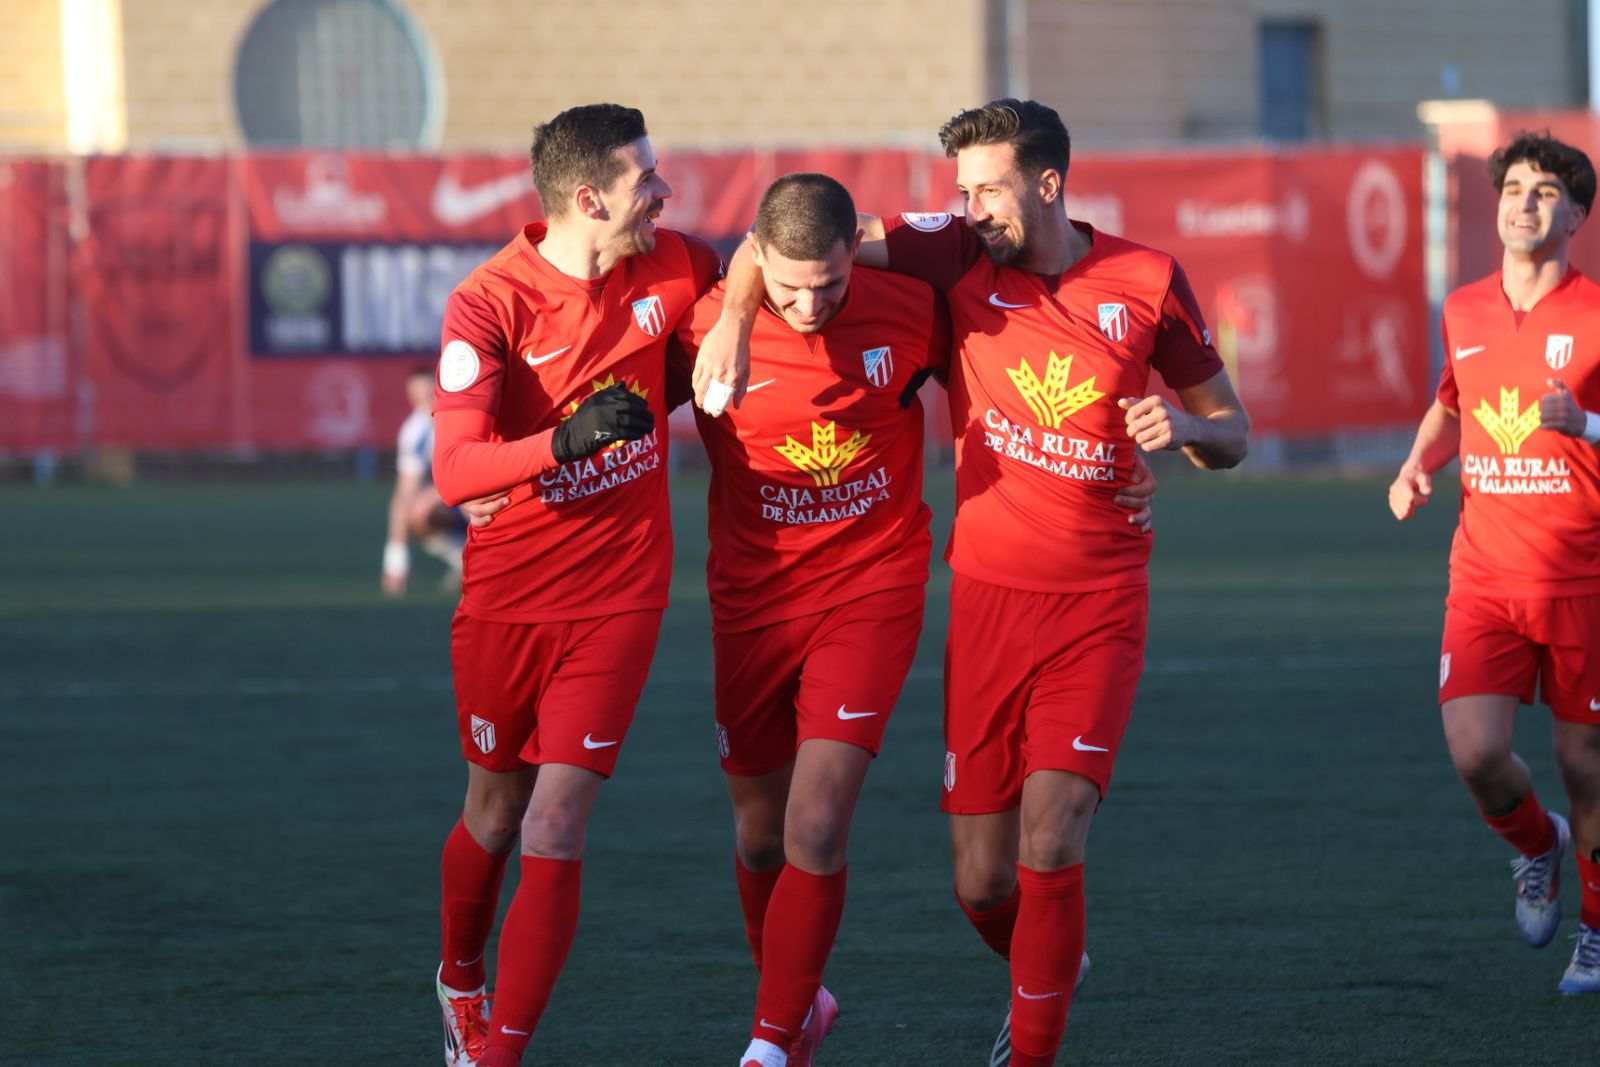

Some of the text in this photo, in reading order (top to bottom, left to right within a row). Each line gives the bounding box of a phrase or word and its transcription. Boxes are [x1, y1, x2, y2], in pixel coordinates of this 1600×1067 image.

[539, 428, 658, 486] CAJA RURAL
[984, 431, 1115, 481] DE SALAMANCA
[985, 408, 1116, 463] CAJA RURAL
[540, 452, 660, 503] DE SALAMANCA
[760, 467, 892, 509] CAJA RURAL
[1464, 454, 1570, 481] CAJA RURAL
[1479, 478, 1572, 495] SALAMANCA
[761, 488, 890, 525] DE SALAMANA
